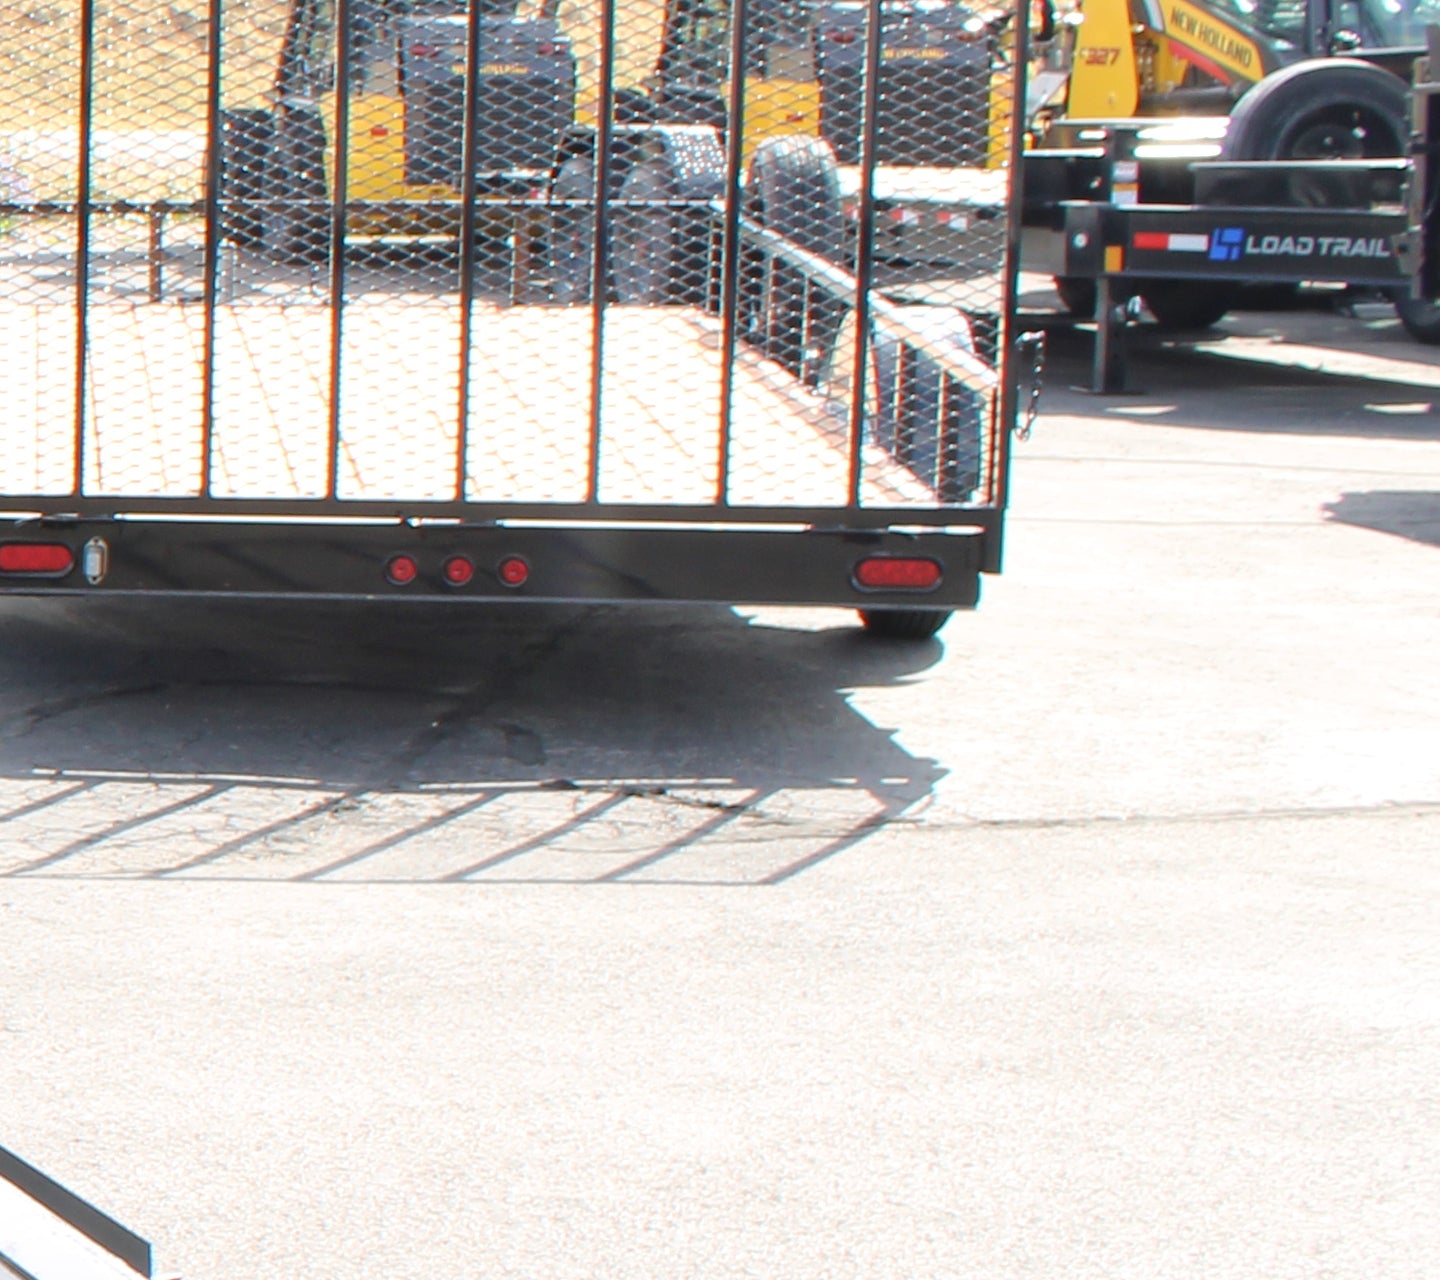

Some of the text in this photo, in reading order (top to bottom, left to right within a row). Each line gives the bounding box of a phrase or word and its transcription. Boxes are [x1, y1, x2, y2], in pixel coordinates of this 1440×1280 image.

[1170, 7, 1253, 68] NEW HOLLAND
[1245, 235, 1391, 258] LOAD TRAIL
